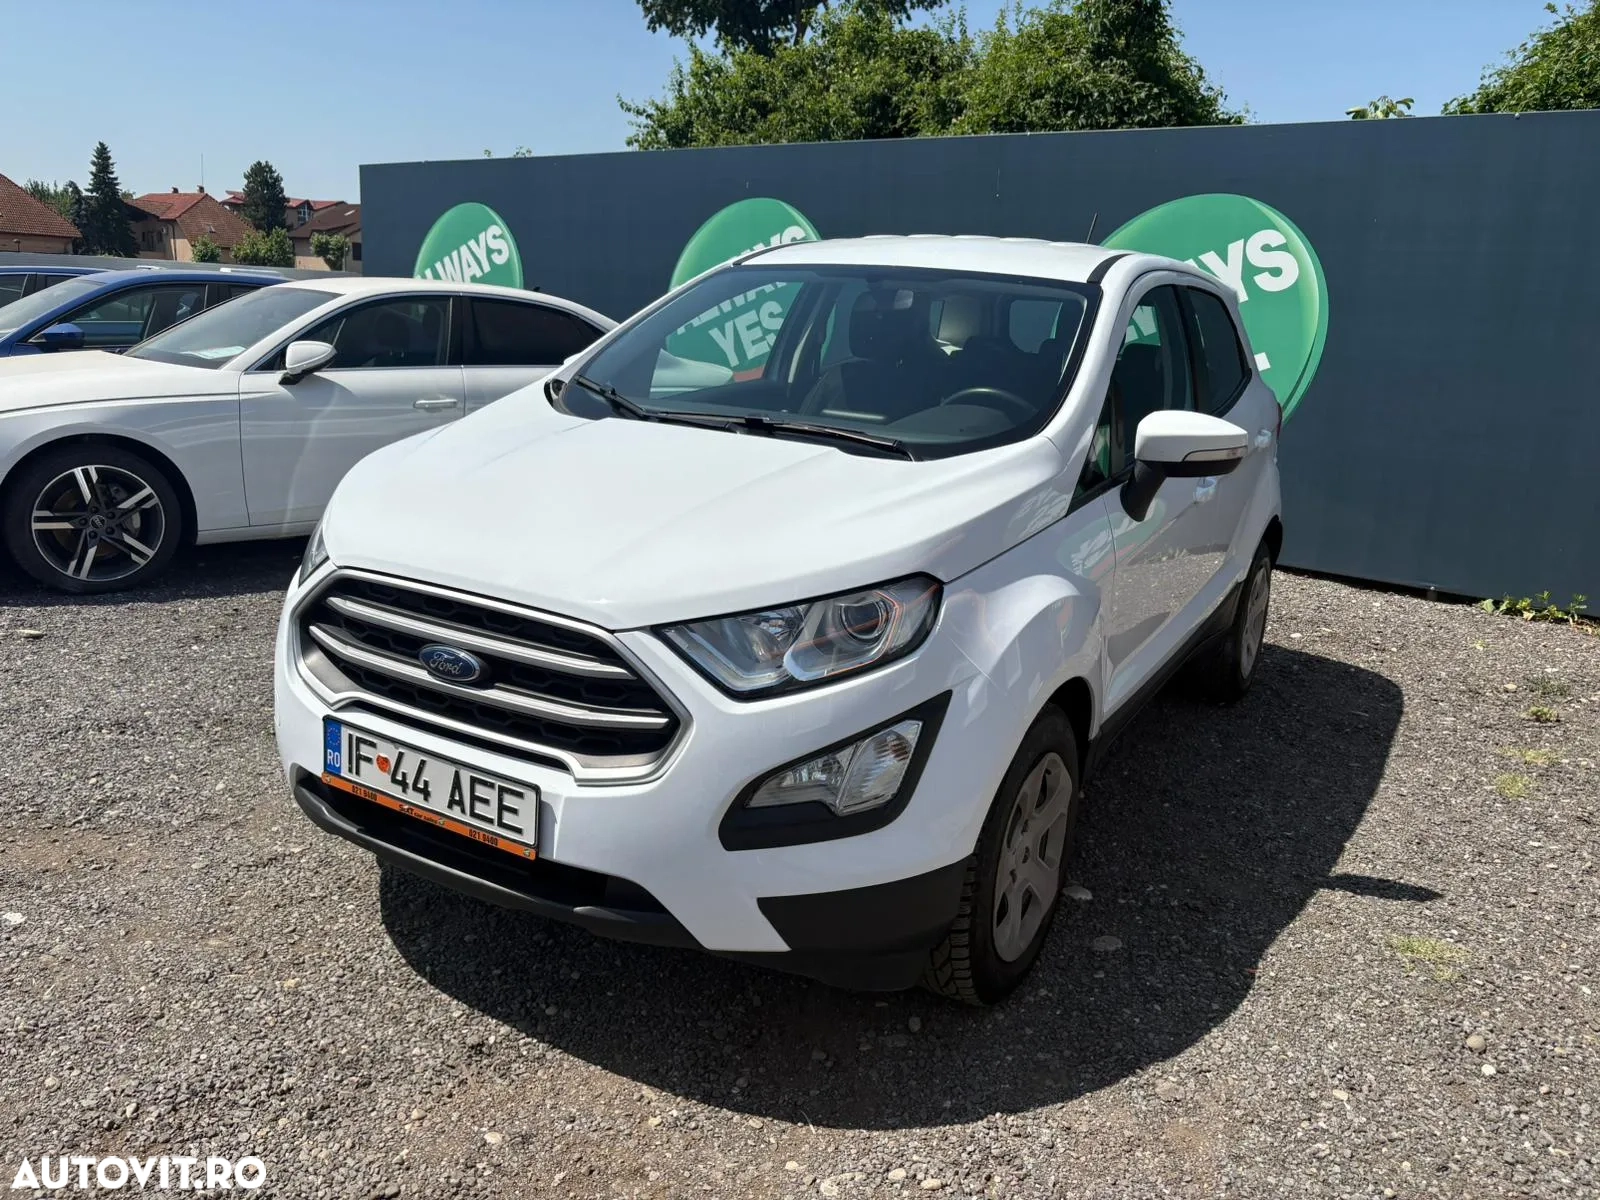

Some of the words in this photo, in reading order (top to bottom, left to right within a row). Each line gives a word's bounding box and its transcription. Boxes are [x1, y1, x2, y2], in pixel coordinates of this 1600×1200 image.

[416, 224, 510, 284] WAYS
[429, 651, 463, 675] Ford
[327, 748, 341, 768] RO
[348, 732, 377, 777] IF
[390, 751, 431, 803] 44
[447, 769, 525, 836] AEE
